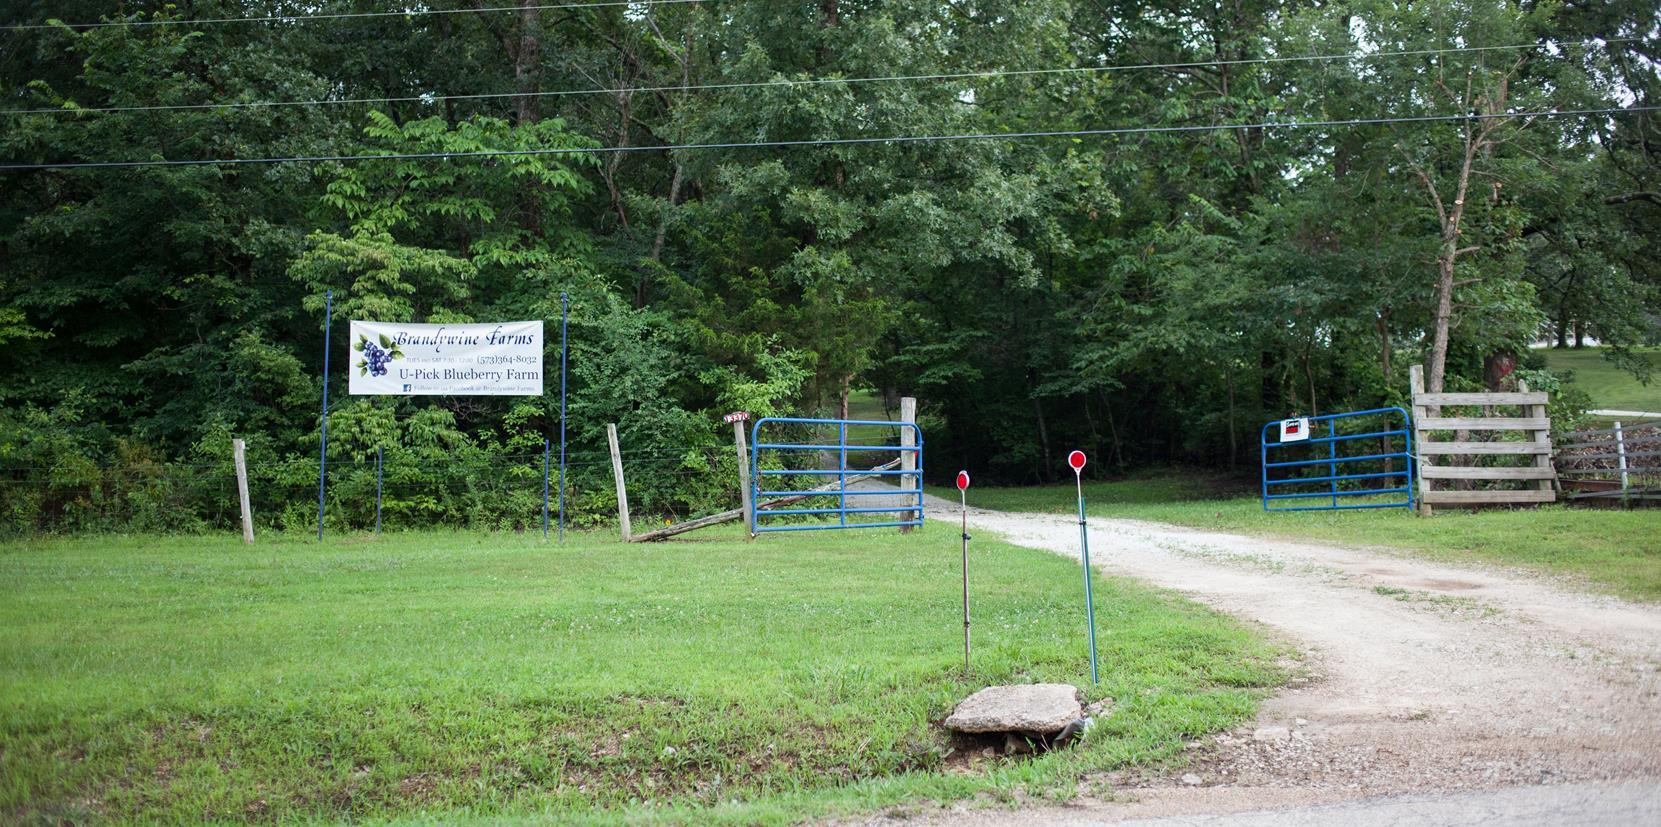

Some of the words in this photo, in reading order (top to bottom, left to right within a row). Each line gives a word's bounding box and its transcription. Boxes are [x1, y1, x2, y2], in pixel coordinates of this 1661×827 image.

[393, 327, 479, 353] Brandywine
[485, 325, 534, 345] Farms
[476, 355, 537, 364] (573)364-8032
[399, 368, 440, 380] U-Pick
[444, 368, 502, 382] Blueberry
[507, 369, 539, 380] Farm
